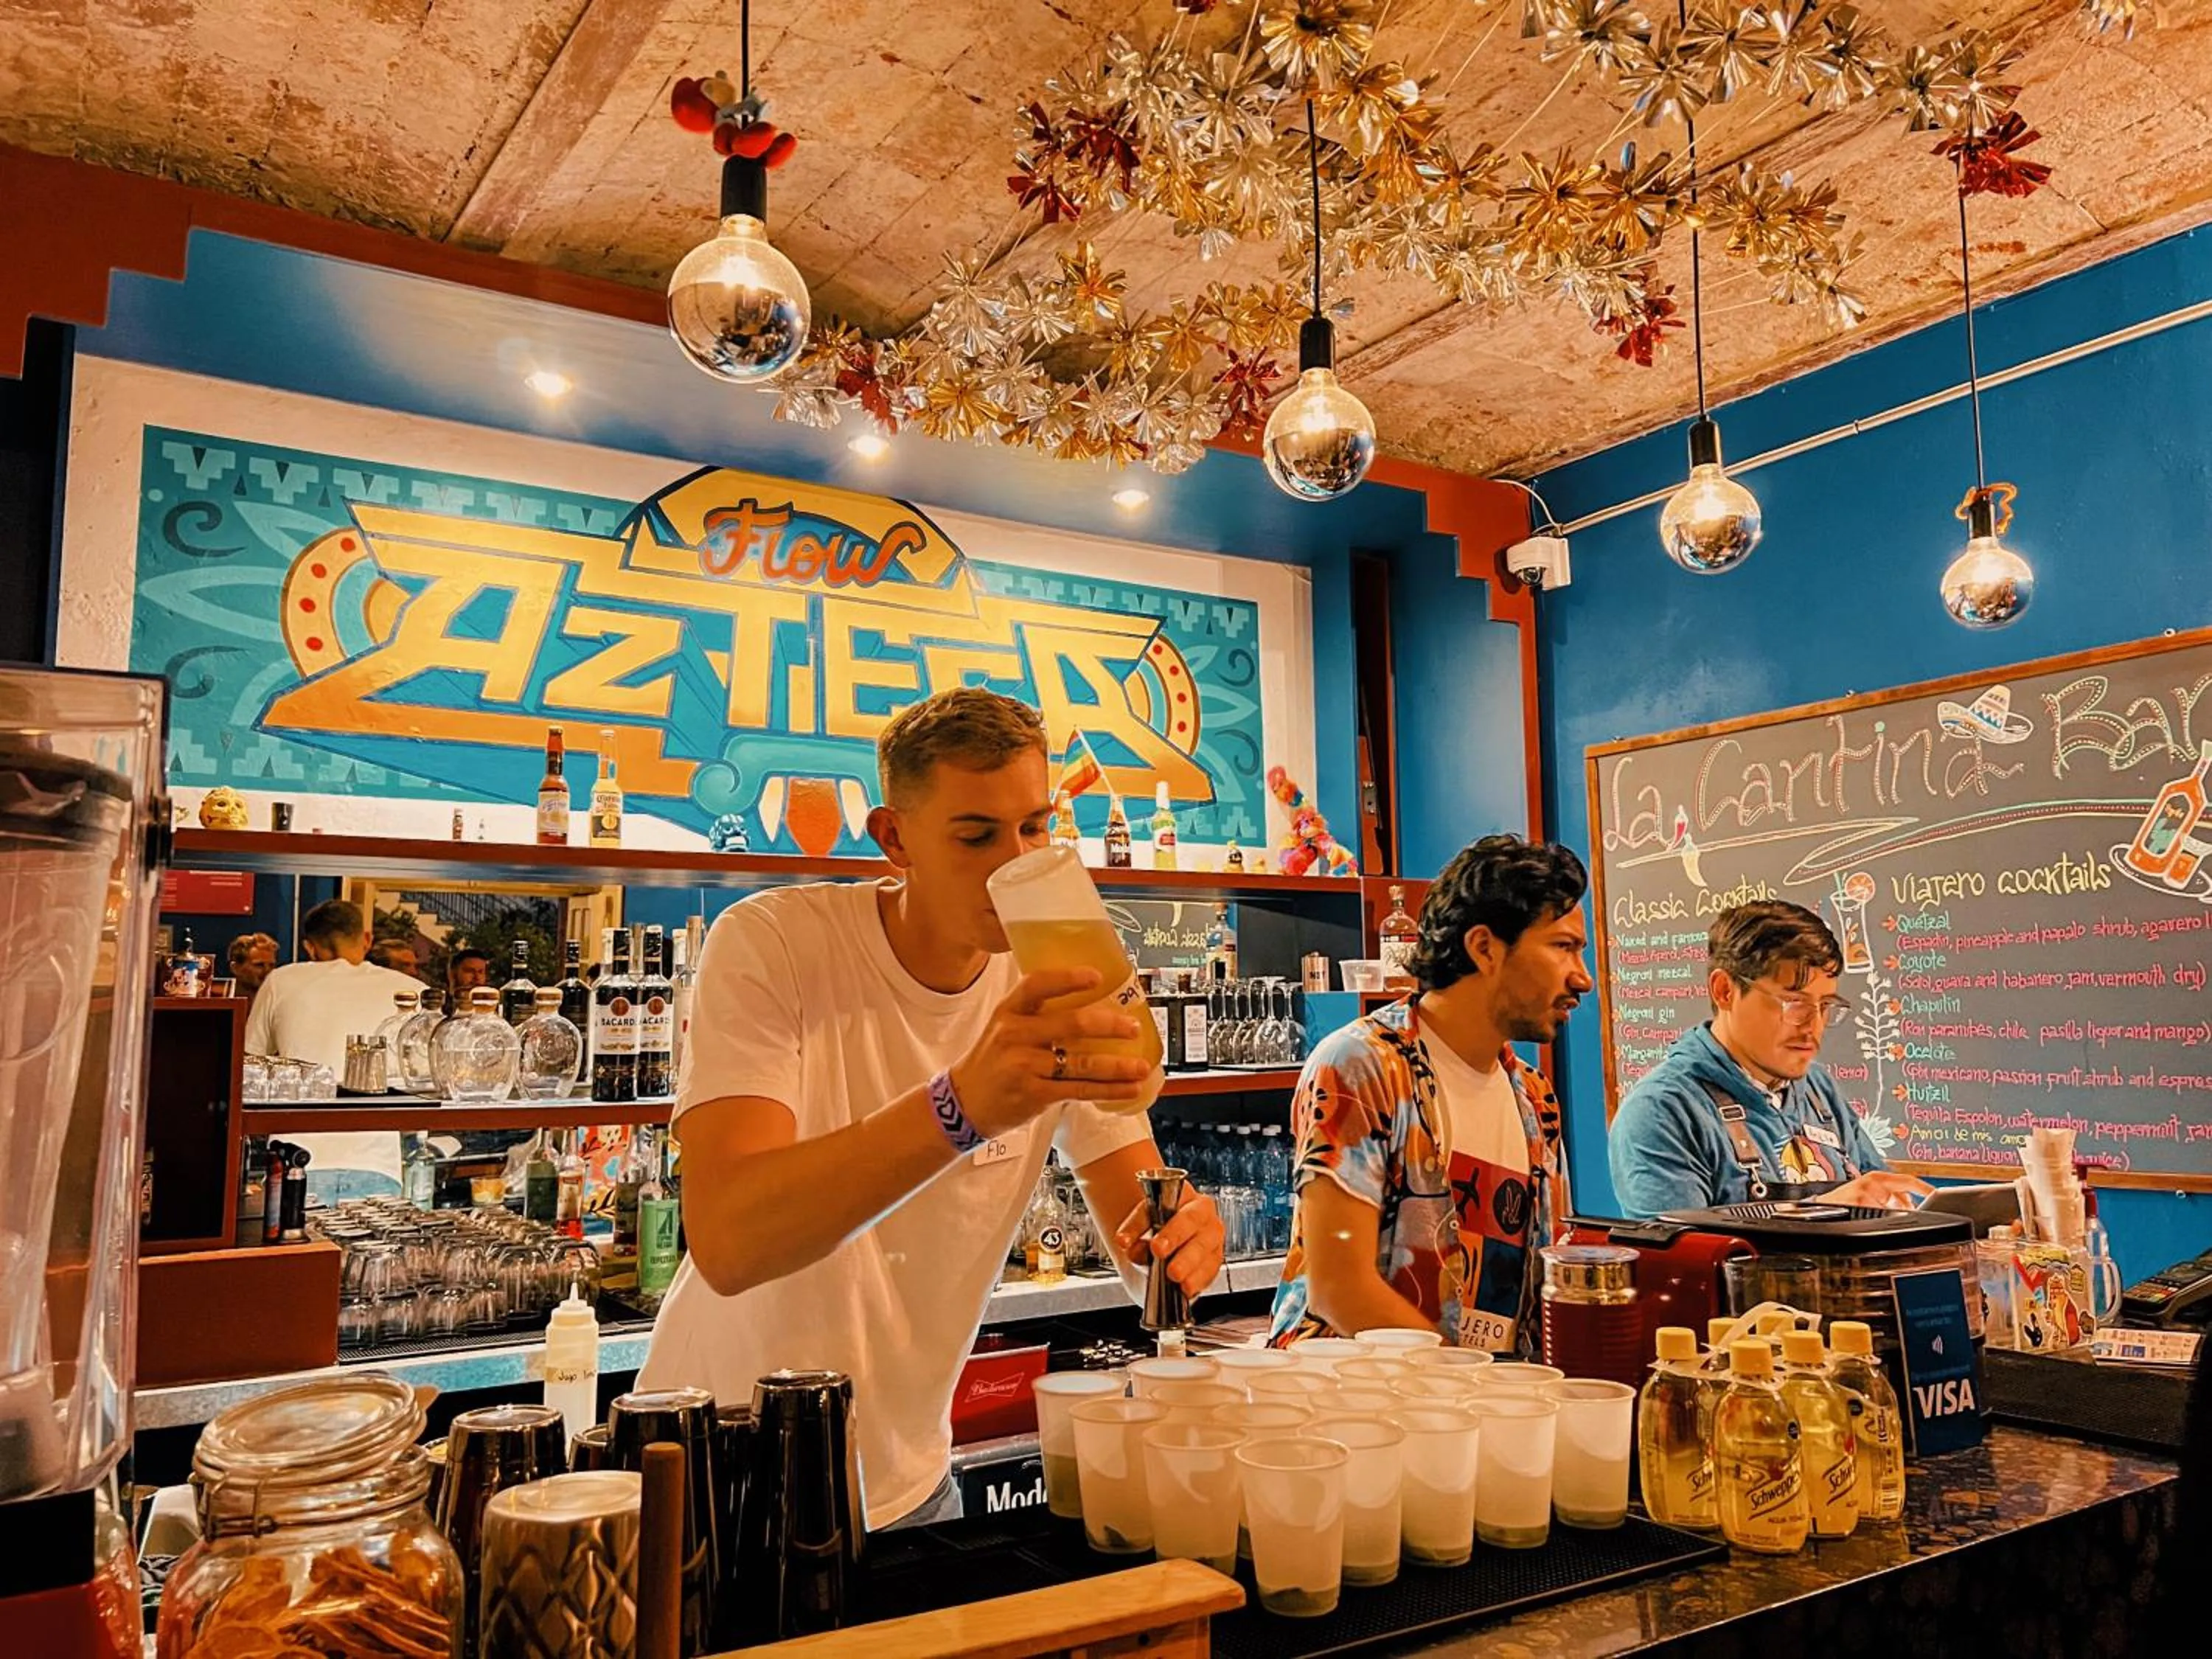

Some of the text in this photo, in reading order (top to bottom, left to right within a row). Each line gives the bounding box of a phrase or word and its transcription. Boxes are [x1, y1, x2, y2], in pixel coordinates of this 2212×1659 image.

[699, 498, 928, 587] Flow
[252, 498, 1215, 804] AZTECA
[1603, 672, 2212, 852] La Cantina Bar
[1891, 851, 2113, 911] Viajero cocktails
[1613, 889, 1688, 928] Classic
[1897, 910, 1952, 933] Quetzal
[1897, 947, 1947, 975] Coyote
[1913, 1378, 1975, 1419] VISA
[986, 1477, 1048, 1514] Mod
[1750, 1470, 1801, 1511] Schweppe
